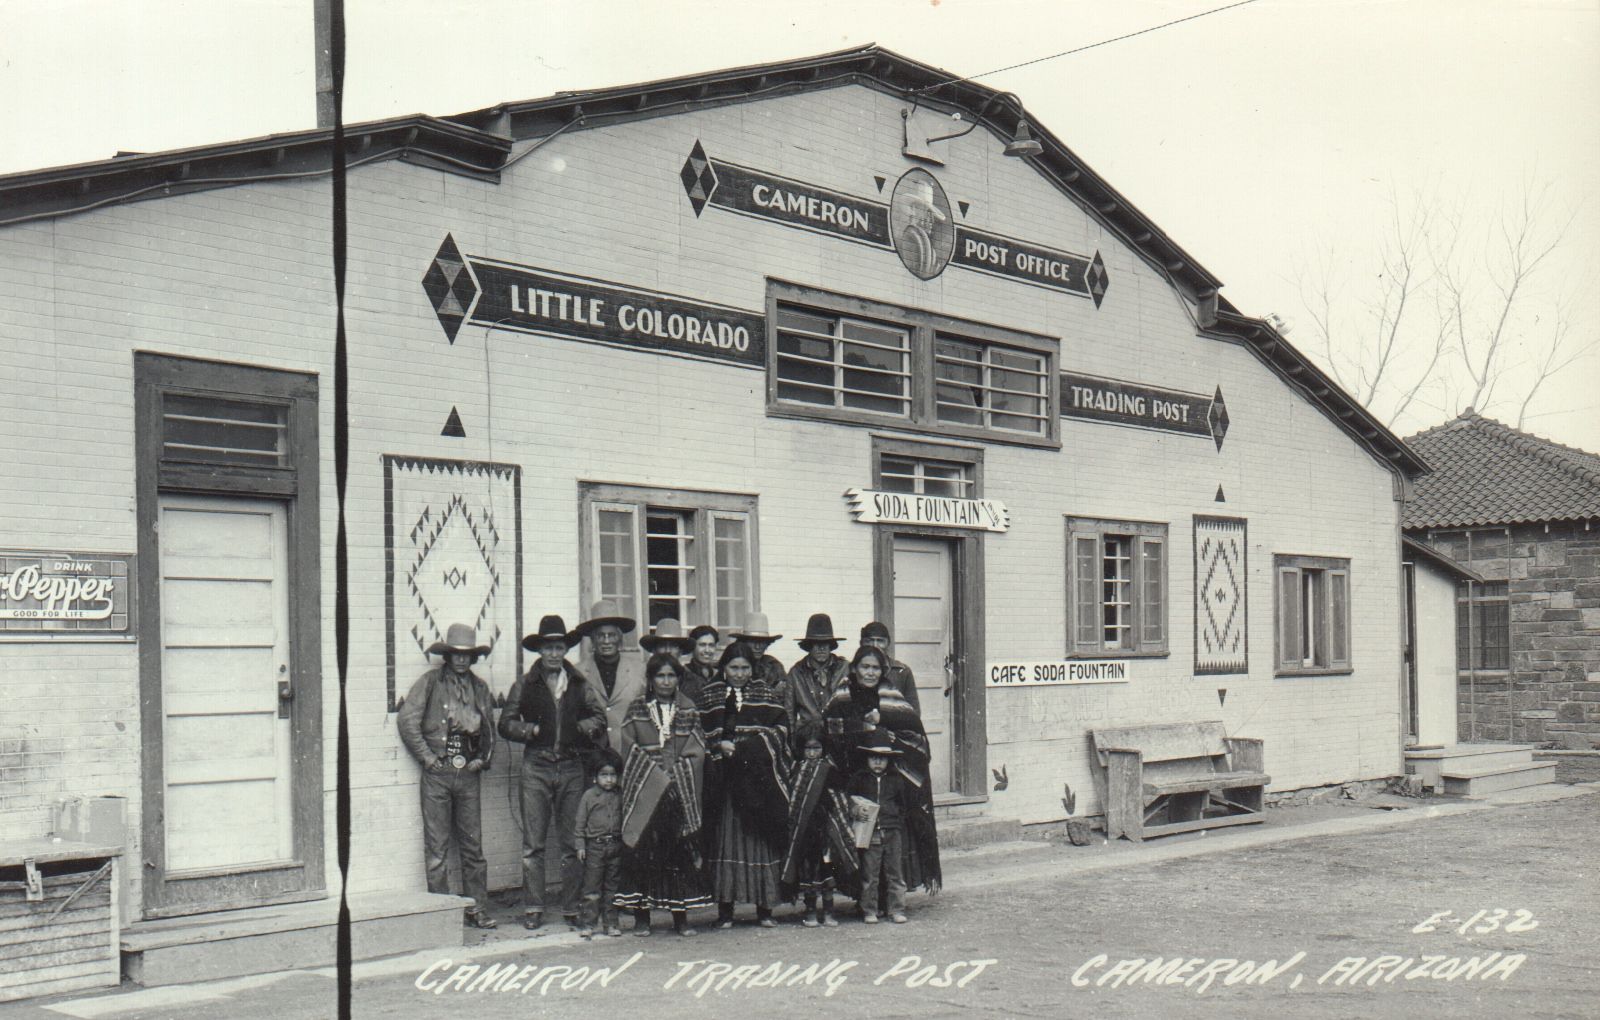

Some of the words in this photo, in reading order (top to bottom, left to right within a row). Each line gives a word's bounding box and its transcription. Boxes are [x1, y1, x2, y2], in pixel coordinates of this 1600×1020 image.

[752, 184, 869, 232] CAMERON
[965, 238, 1009, 267] POST
[1015, 252, 1070, 282] OFFICE
[511, 285, 605, 327] LITTLE
[618, 304, 749, 352] COLORADO
[1071, 385, 1145, 416] TRADING
[1153, 399, 1190, 423] POST
[874, 493, 910, 520] SODA
[916, 497, 980, 524] FOUNTAIN
[54, 562, 93, 572] DRINK
[8, 564, 115, 612] Pepper
[13, 610, 38, 618] GOOD
[43, 610, 60, 618] FOR
[991, 665, 1026, 683] CAFE
[1034, 664, 1066, 681] SODA
[1070, 662, 1125, 680] FOUNTAIN
